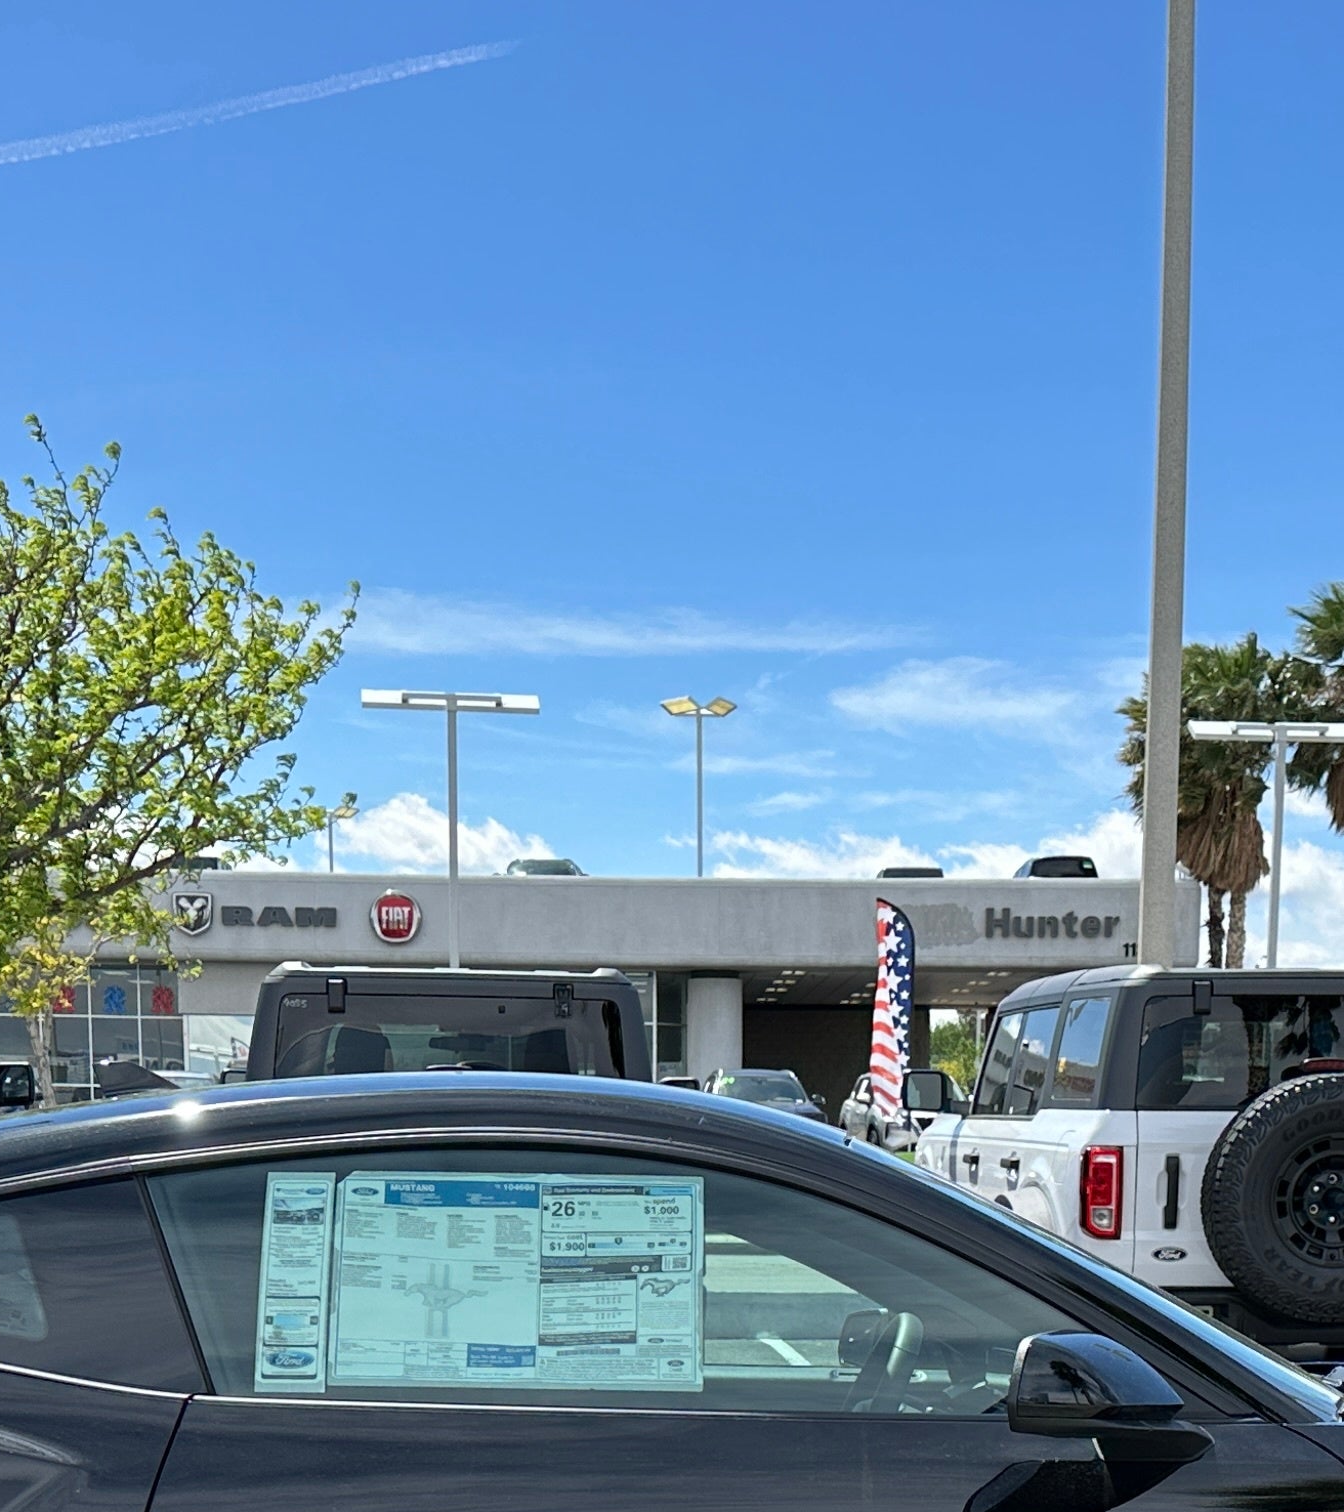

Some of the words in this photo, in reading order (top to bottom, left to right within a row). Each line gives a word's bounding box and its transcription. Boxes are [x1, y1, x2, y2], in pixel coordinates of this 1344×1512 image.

[221, 906, 337, 927] RAM
[381, 906, 411, 929] FIAT
[985, 907, 1120, 939] Hunter
[390, 1183, 436, 1192] MUSTANG
[552, 1201, 575, 1217] 26
[644, 1206, 679, 1215] $1,000
[549, 1241, 585, 1251] $1,900
